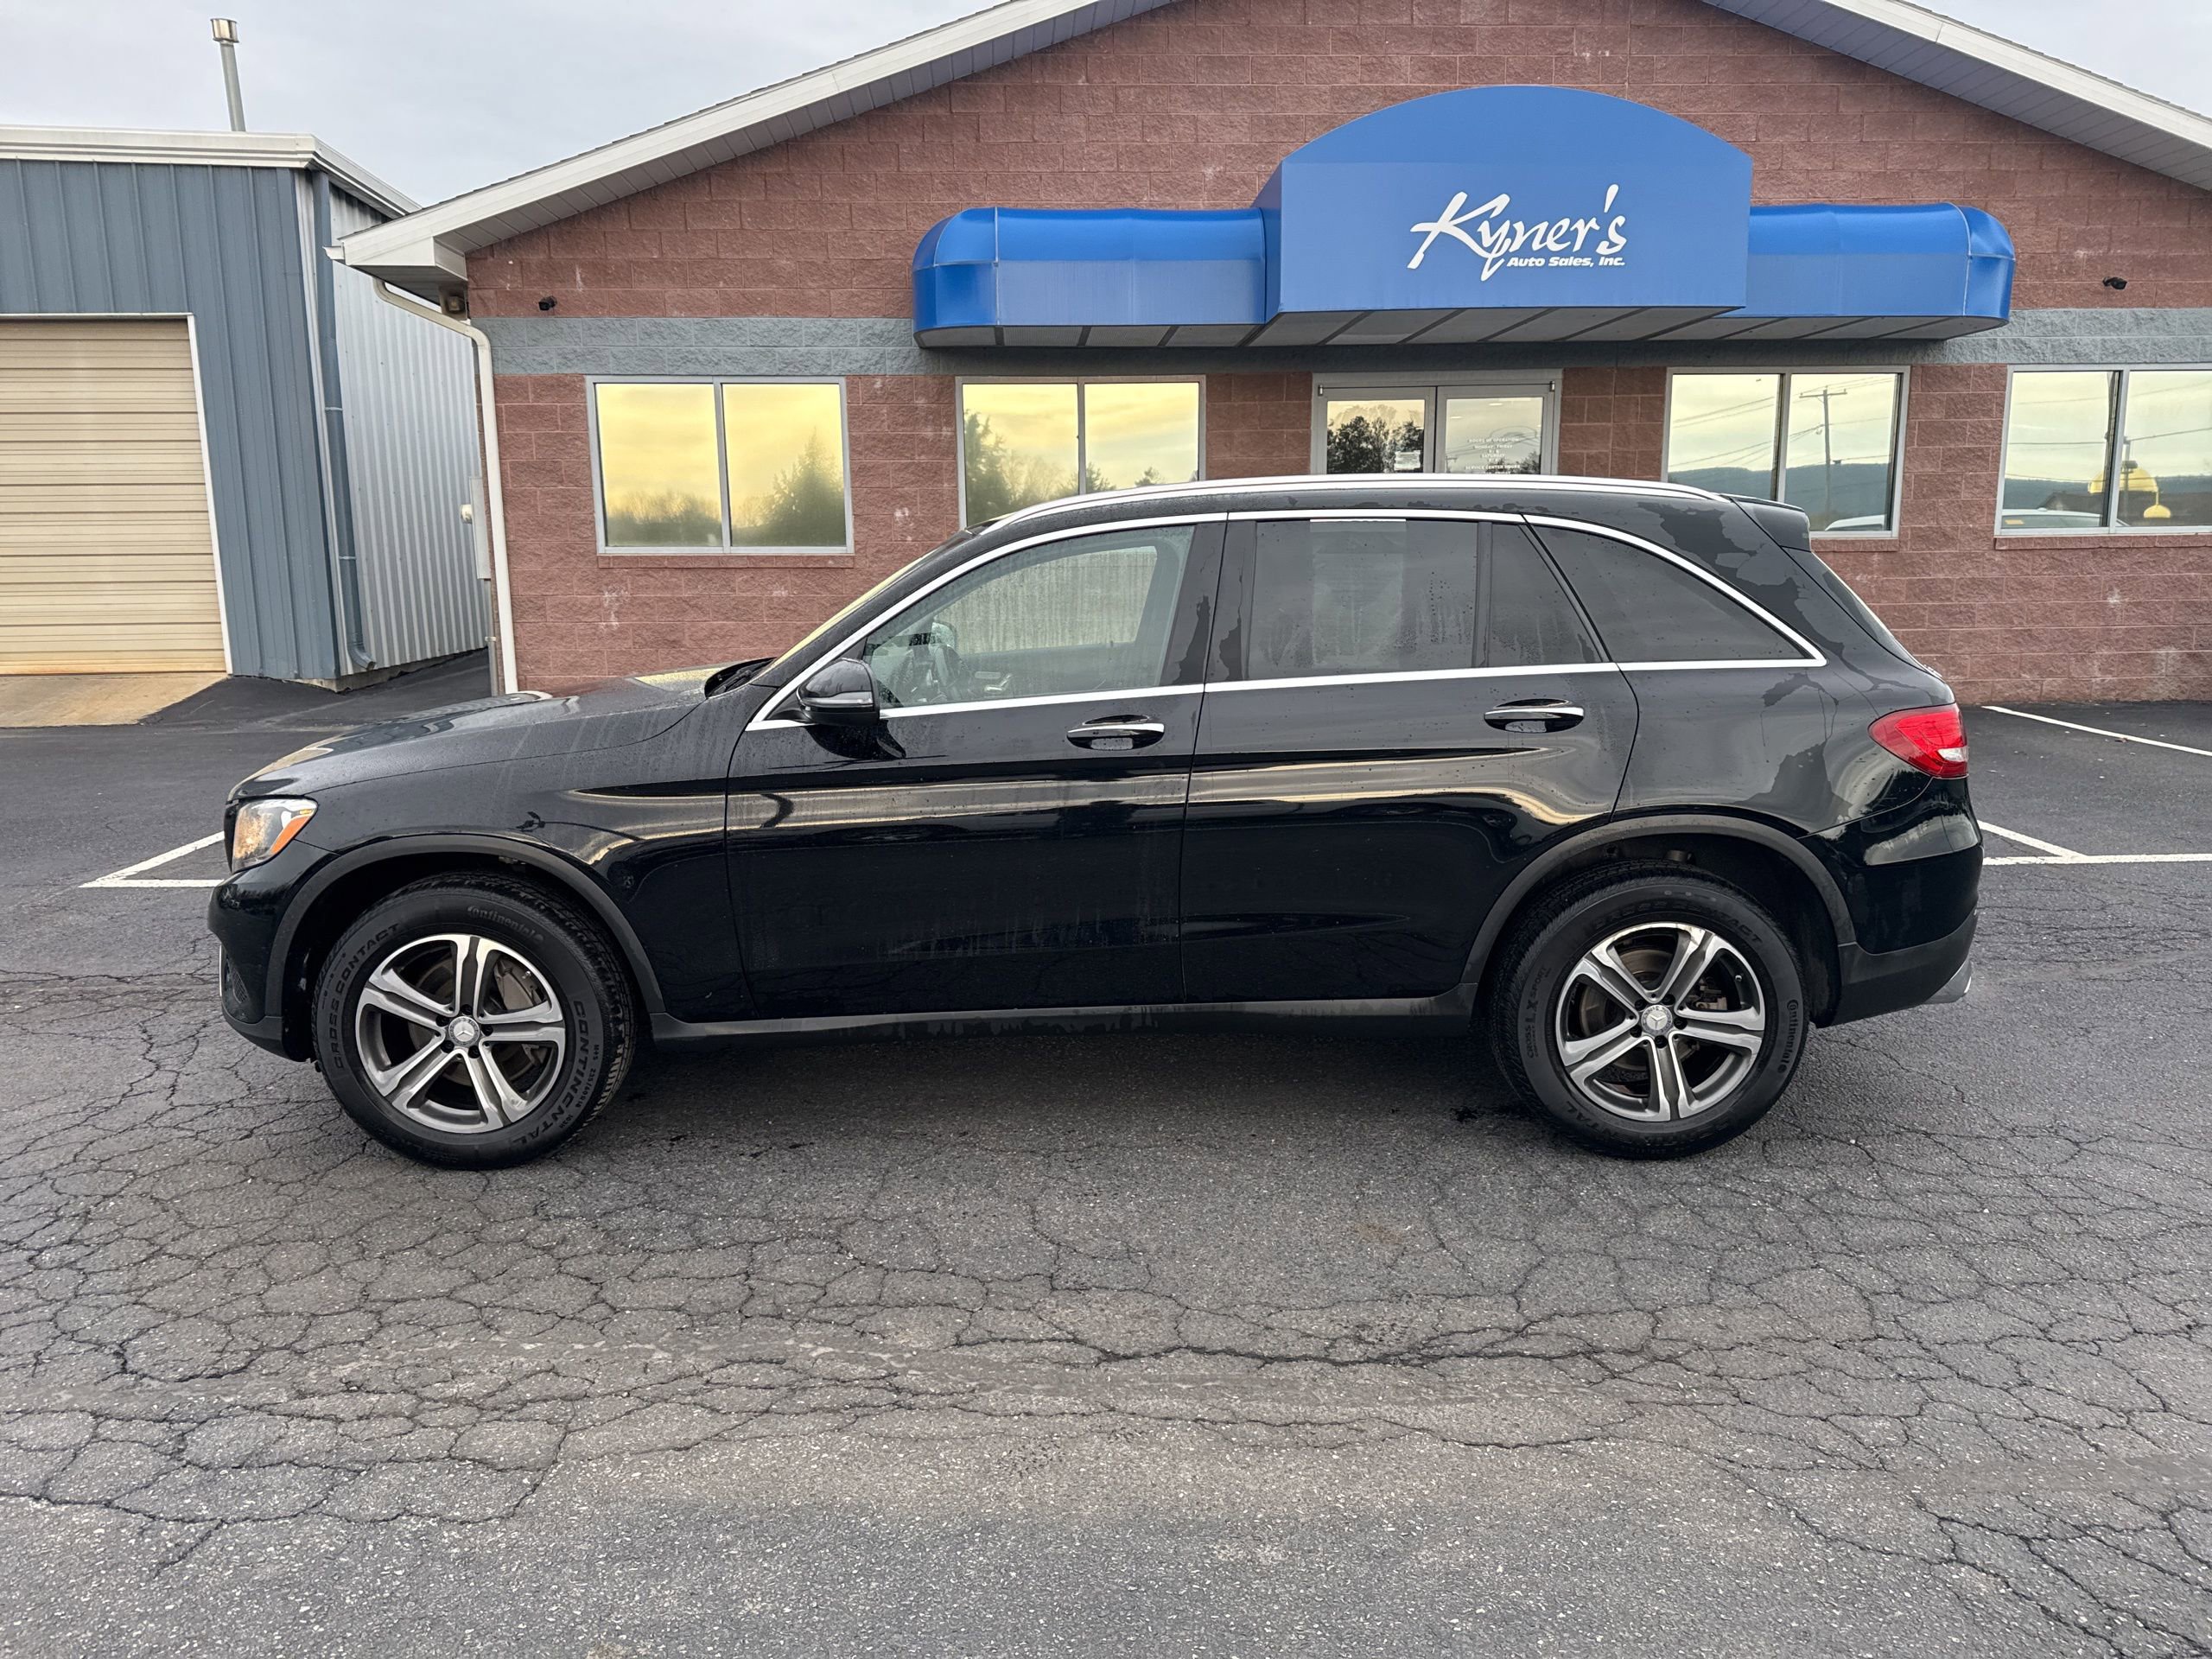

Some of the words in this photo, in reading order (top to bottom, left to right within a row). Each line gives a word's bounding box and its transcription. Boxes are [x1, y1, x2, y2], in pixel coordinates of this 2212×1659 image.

[1407, 184, 1628, 282] Kyner's
[1507, 256, 1546, 267] Auto
[1548, 256, 1593, 268] Sales,
[1599, 256, 1626, 267] Inc.
[467, 906, 537, 939] Continental
[334, 923, 399, 995] CONTACT
[1529, 966, 1547, 999] SPORT
[328, 997, 345, 1070] CROSS
[1524, 999, 1540, 1023] LX
[1780, 999, 1799, 1064] Continental
[1524, 1024, 1535, 1059] CROSS
[512, 1000, 590, 1144] CONTINENTAL
